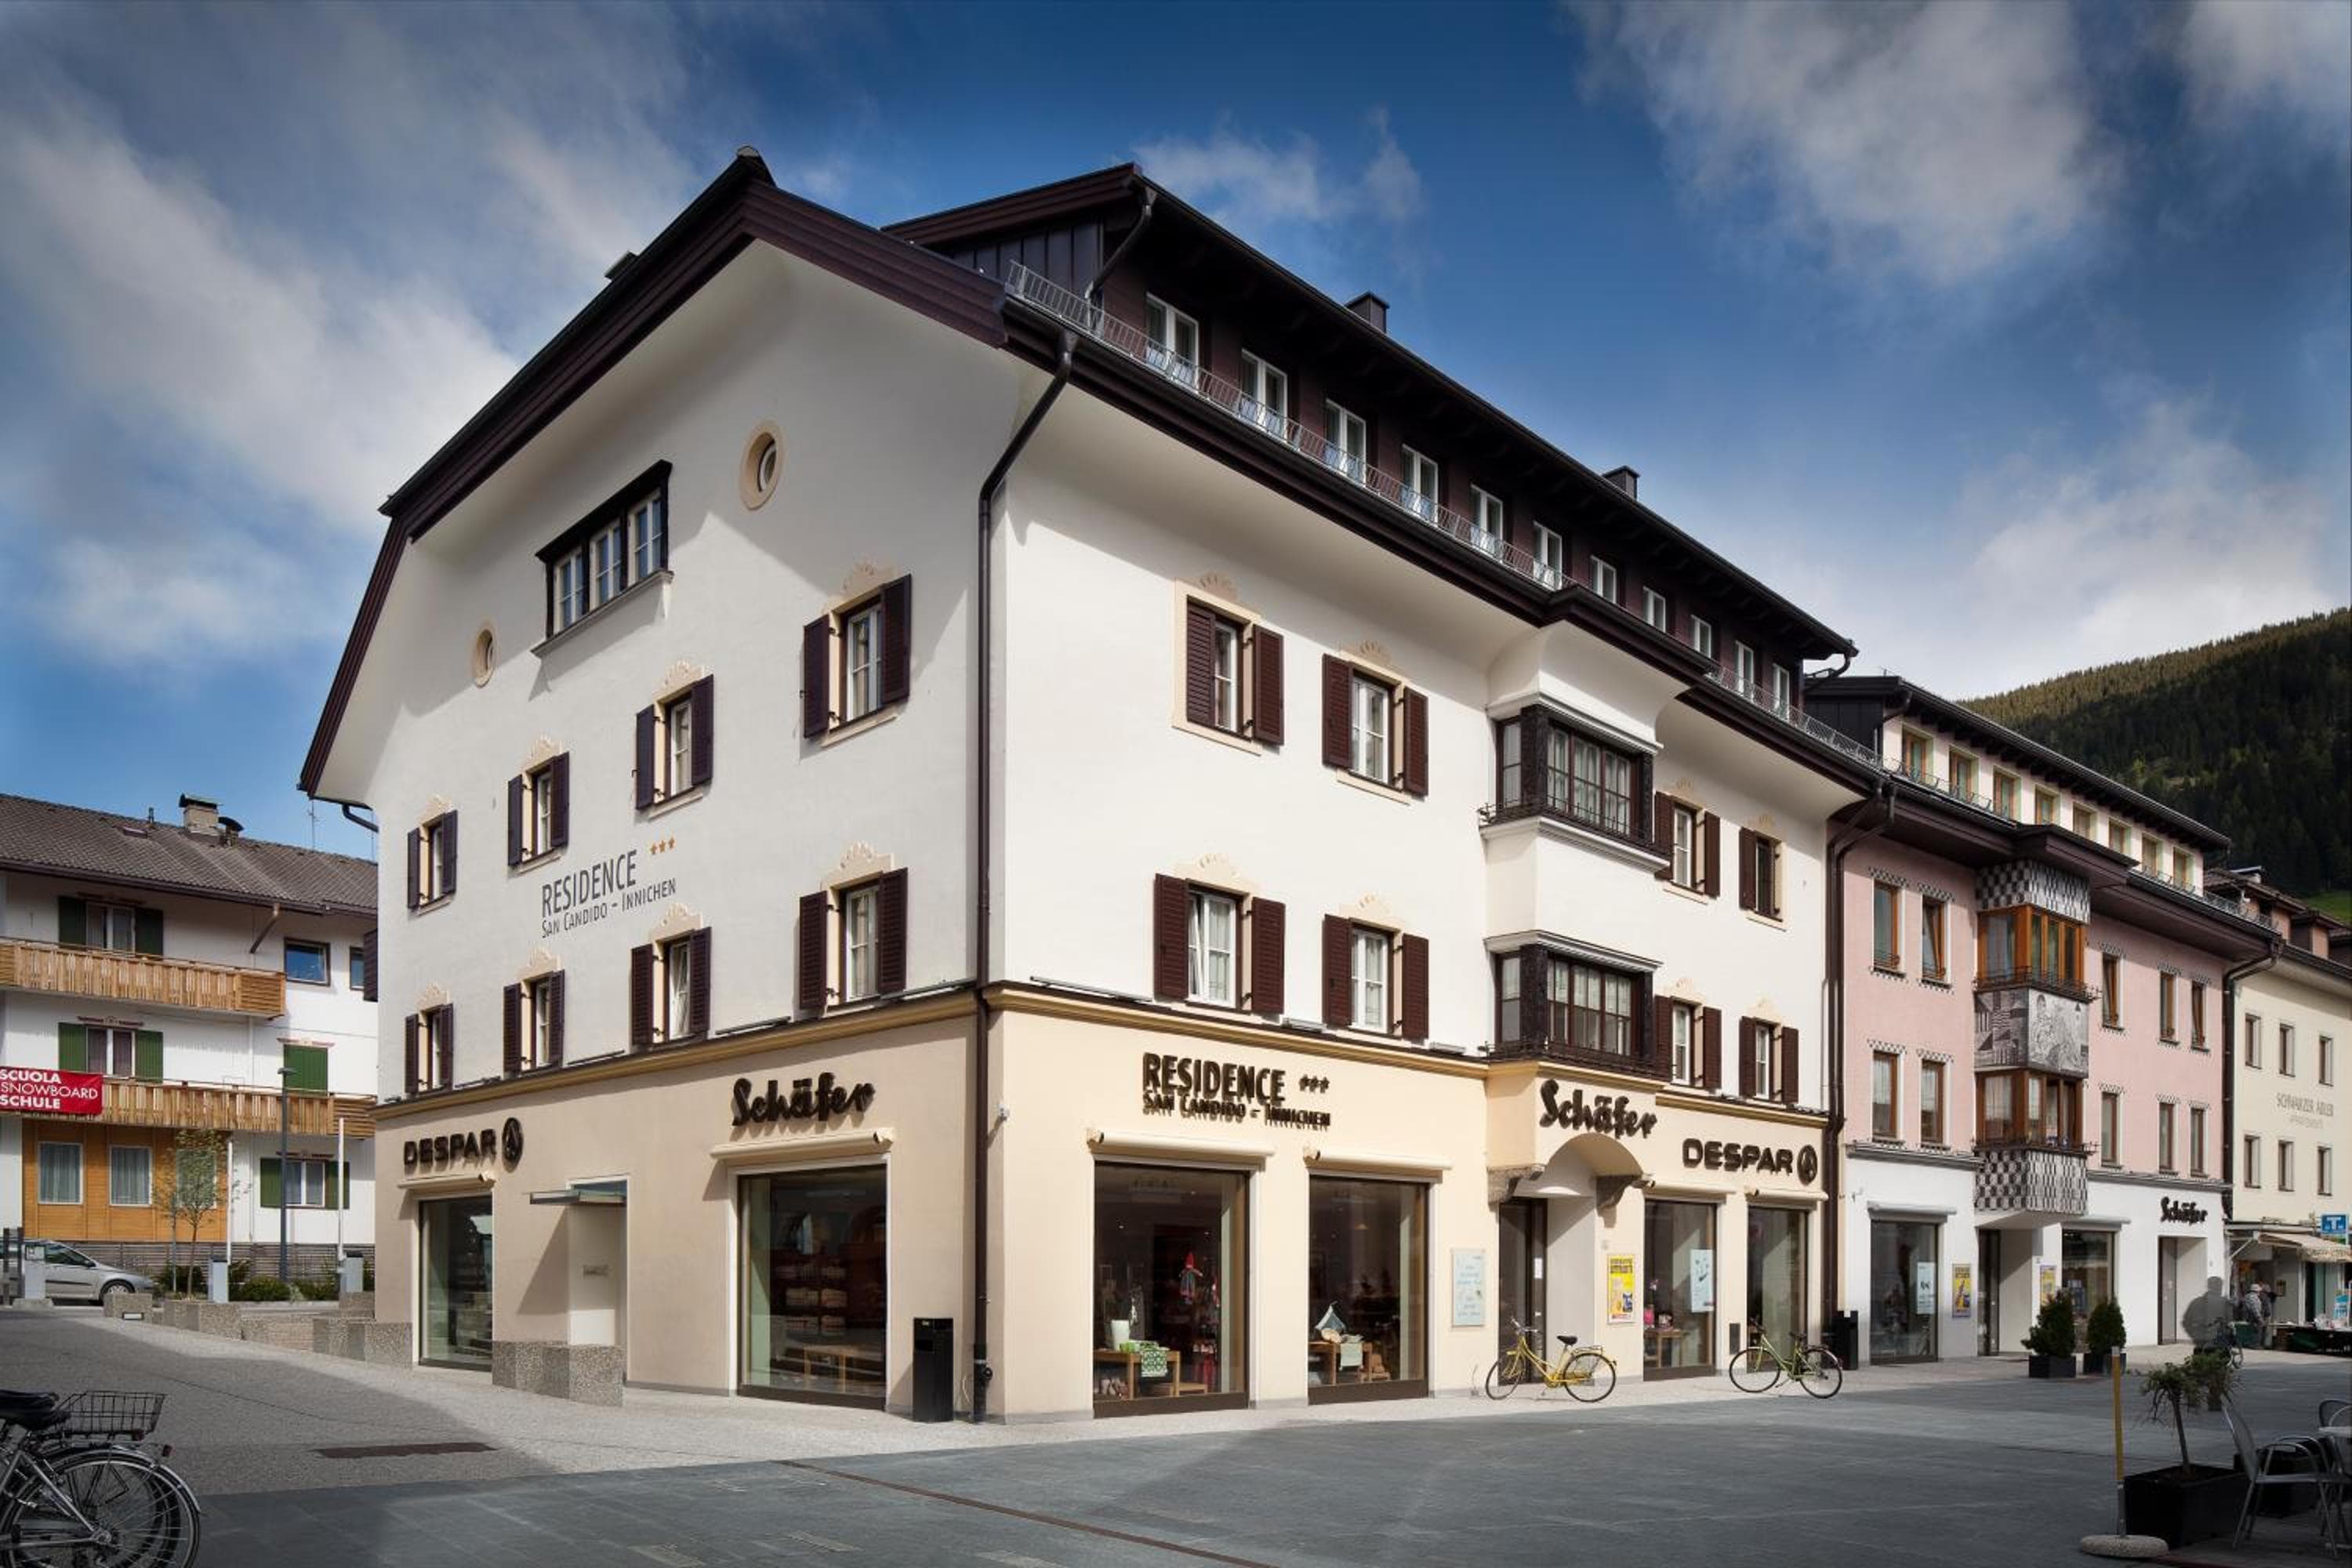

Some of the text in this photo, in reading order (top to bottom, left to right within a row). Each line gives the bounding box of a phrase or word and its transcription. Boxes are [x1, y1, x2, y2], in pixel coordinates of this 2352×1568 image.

[542, 850, 637, 918] RESIDENCE
[542, 918, 560, 938] SAN
[564, 902, 608, 931] CANDIDO
[622, 878, 677, 912] INNICHEN
[0, 1069, 62, 1083] SCUOLA
[1, 1081, 98, 1099] SNOWBOARD
[1142, 1052, 1286, 1105] RESIDENCE
[0, 1094, 60, 1109] SCHULE
[731, 1071, 876, 1127] Schäfer
[1142, 1090, 1174, 1111] SAN
[1180, 1094, 1247, 1120] CANDIDO
[1265, 1103, 1331, 1128] INNICHEN
[1540, 1079, 1657, 1139] Schäfer
[404, 1128, 497, 1166] DESPAR
[1682, 1138, 1794, 1174] DESPAR
[2160, 1196, 2209, 1226] Schäfer
